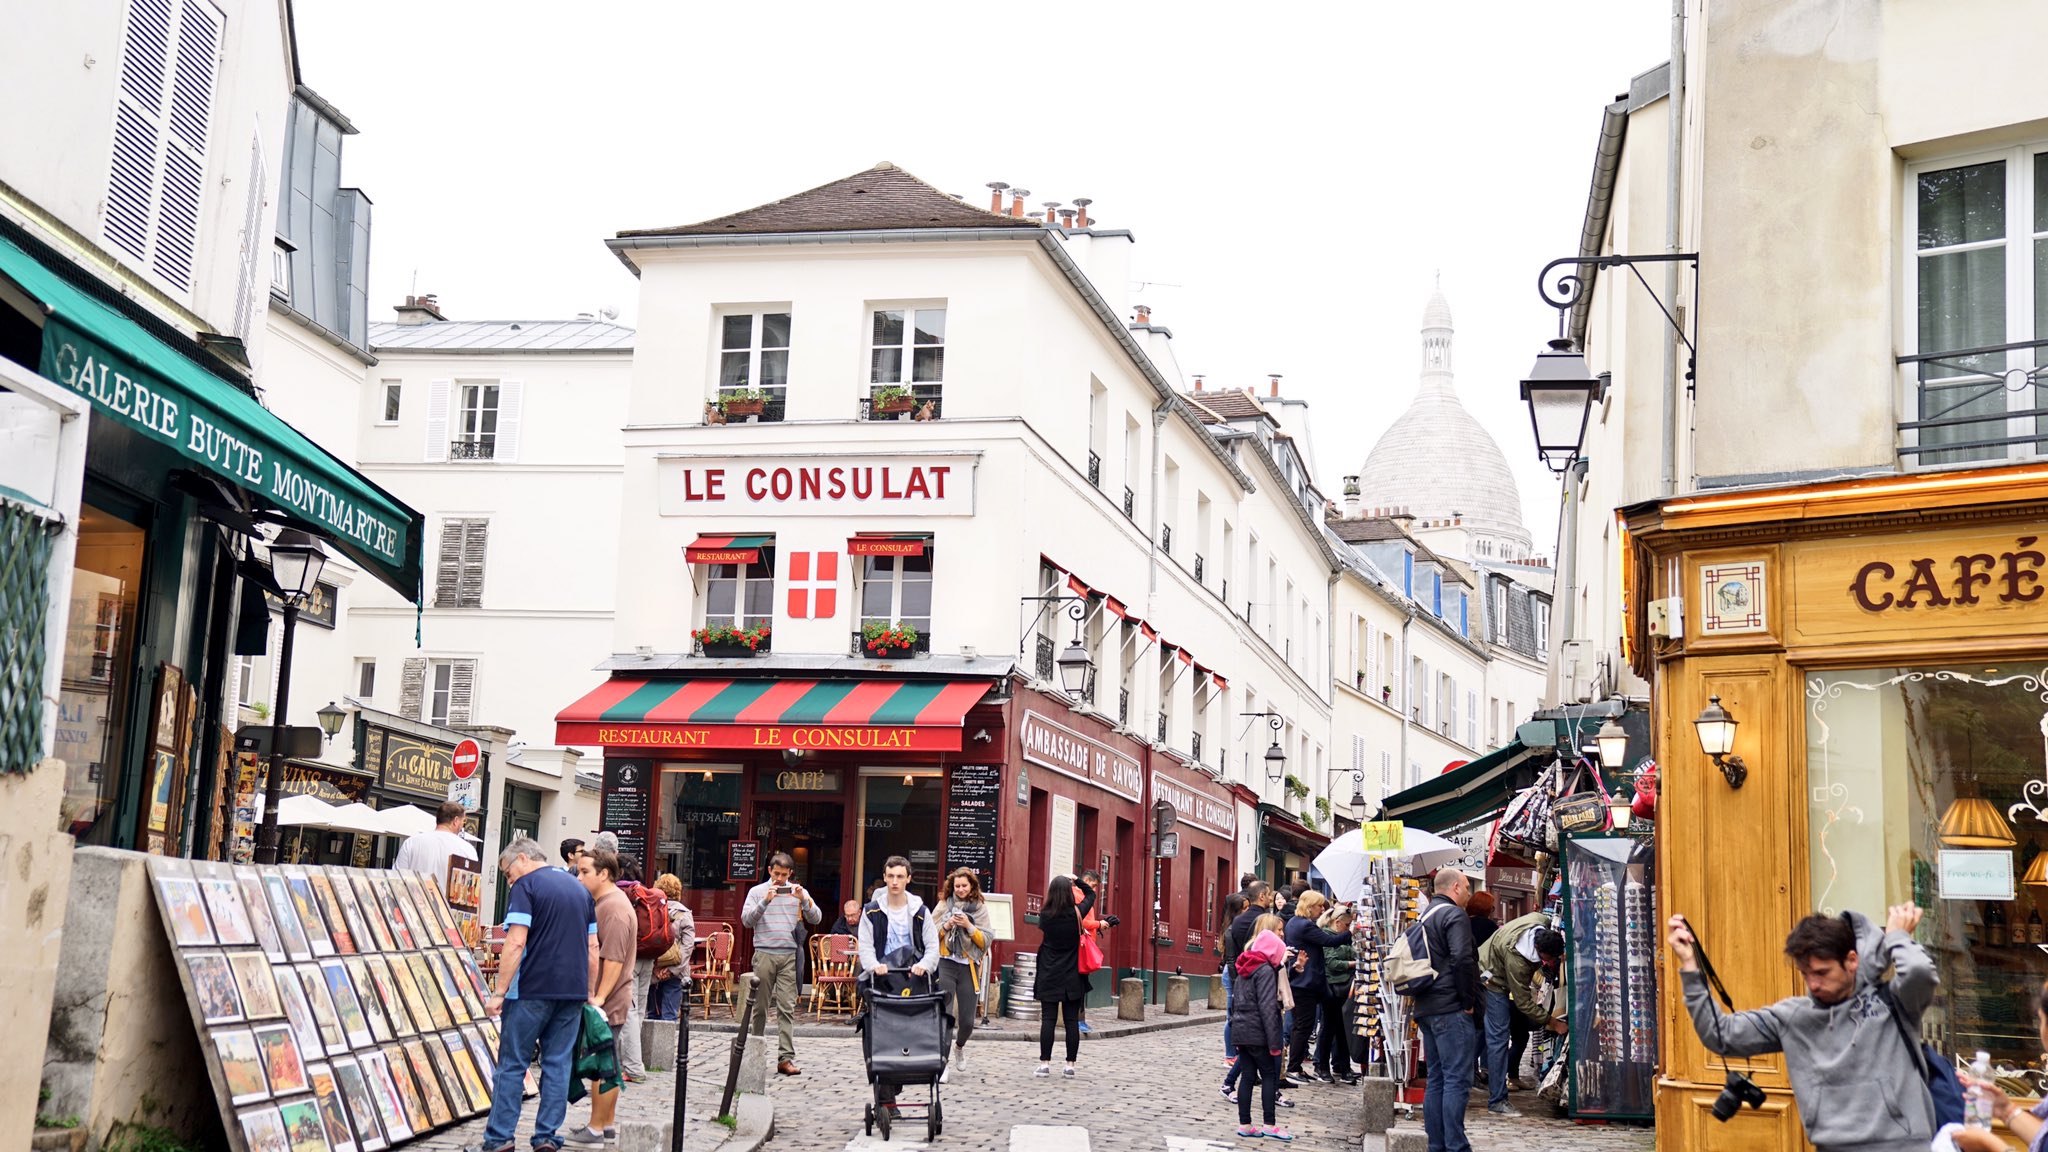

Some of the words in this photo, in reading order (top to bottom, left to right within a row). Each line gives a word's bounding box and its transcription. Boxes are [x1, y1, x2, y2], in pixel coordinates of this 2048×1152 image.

[55, 343, 180, 440] GALERIE
[187, 413, 263, 485] BUTTE
[272, 461, 398, 559] MONTMARTRE
[684, 469, 726, 501] LE
[745, 466, 951, 502] CONSULAT
[696, 552, 748, 561] RESTAURANT
[856, 543, 868, 552] LE
[870, 543, 914, 552] CONSULAT
[1849, 536, 2046, 612] CAFÉ
[598, 728, 710, 746] RESTAURANT
[754, 728, 781, 746] LE
[792, 728, 916, 748] CONSULAT
[398, 755, 407, 770] LA
[409, 754, 441, 780] CAVE
[442, 765, 453, 780] DE
[1026, 723, 1089, 771] AMBASSADE
[1095, 752, 1106, 778] DE
[1112, 760, 1140, 793] SAVOIE
[281, 765, 322, 796] VINS
[421, 777, 449, 792] FRANQUETT
[455, 781, 471, 792] SAUF
[776, 768, 824, 791] CAFÉ
[1152, 780, 1193, 816] RESTAURANT
[1196, 798, 1204, 820] LE
[1205, 803, 1233, 834] CONSULAT
